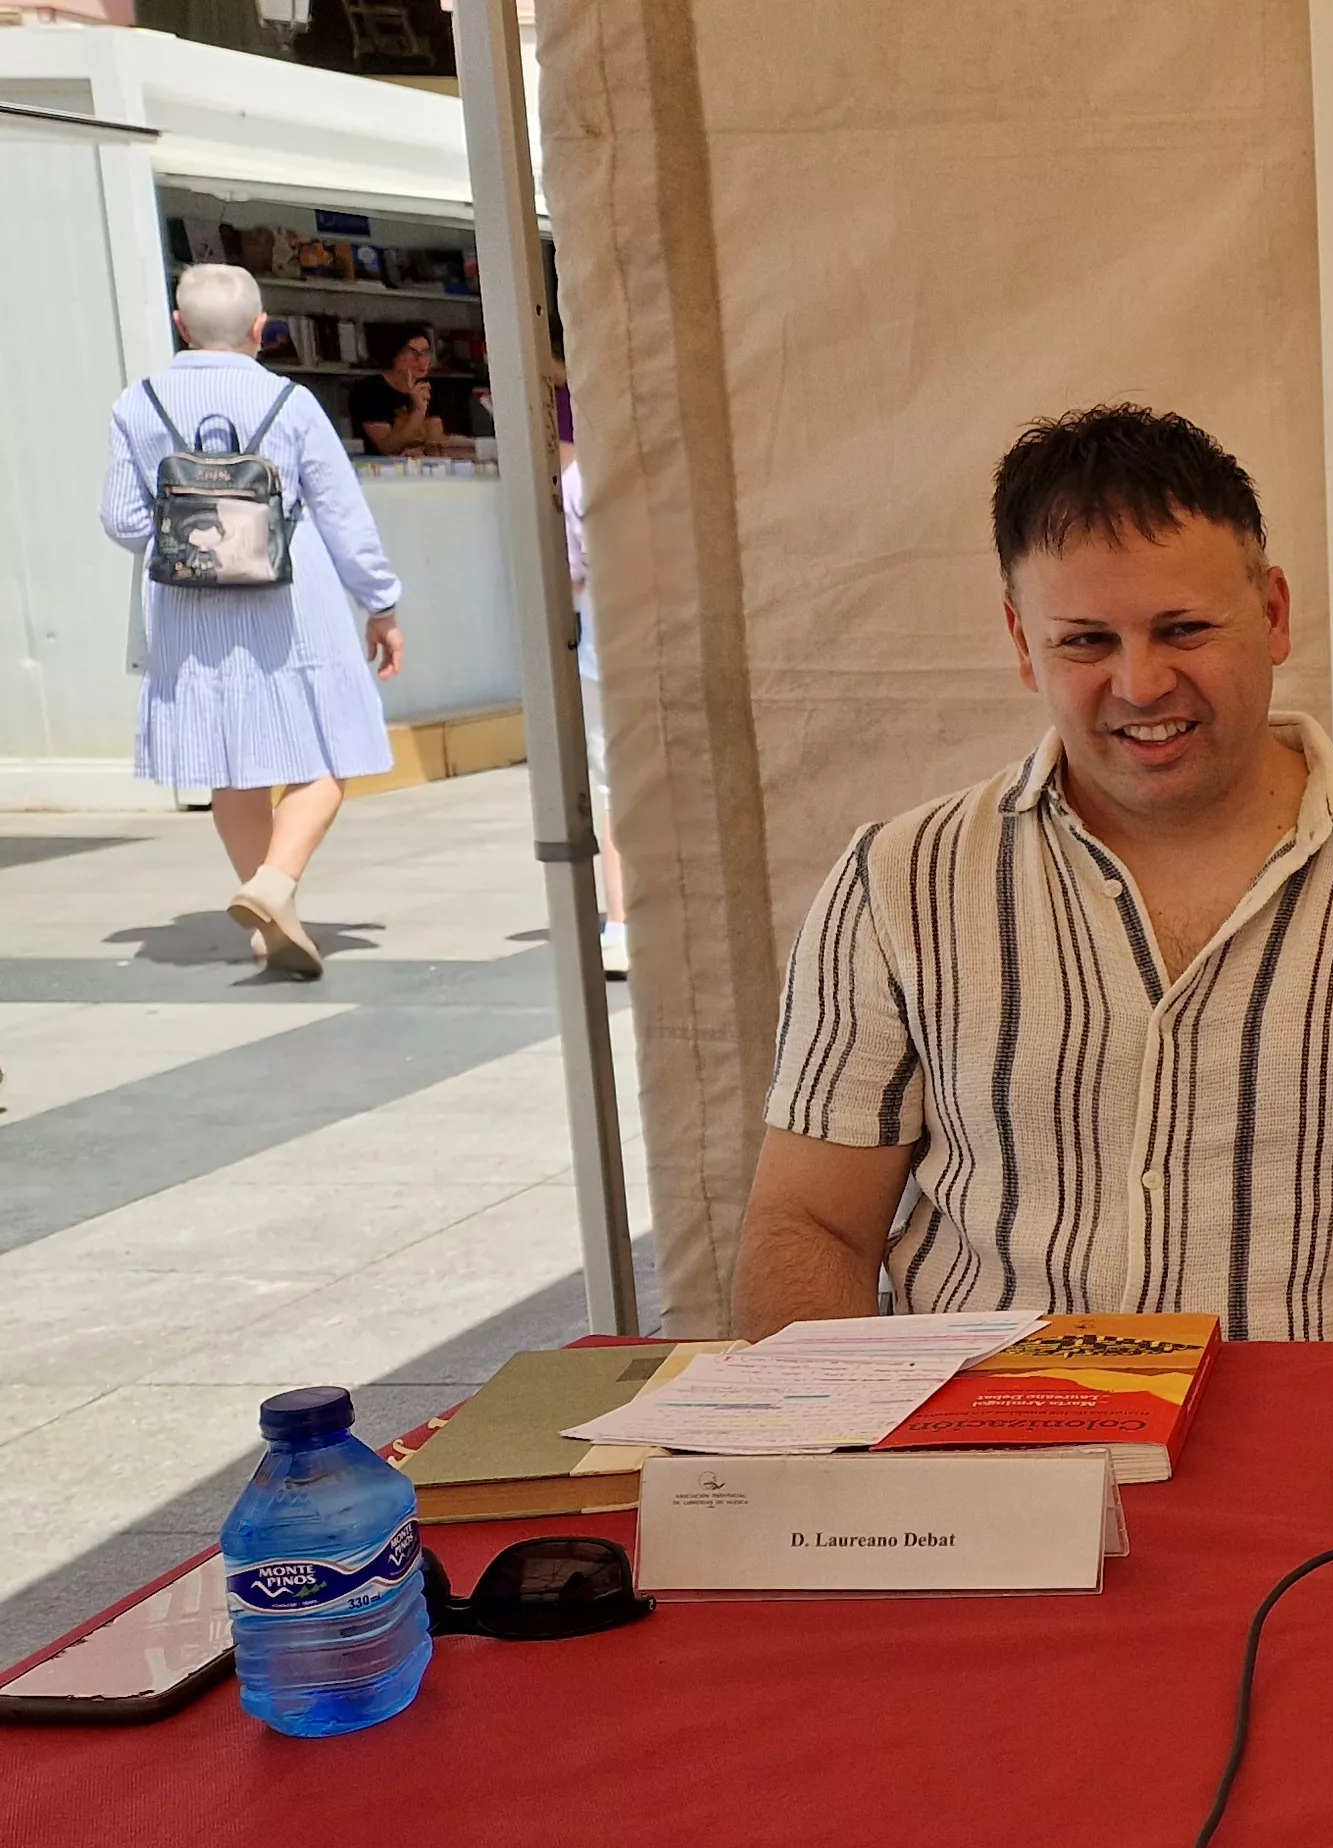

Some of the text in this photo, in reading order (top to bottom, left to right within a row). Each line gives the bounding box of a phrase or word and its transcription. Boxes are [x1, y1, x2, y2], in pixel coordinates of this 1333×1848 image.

[971, 1400, 1047, 1408] Armingol
[907, 1418, 1148, 1433] Colonización
[790, 1531, 957, 1548] D. Laureano Debat
[258, 1564, 316, 1578] MONTE
[267, 1573, 317, 1588] PINOS
[347, 1594, 370, 1611] 330
